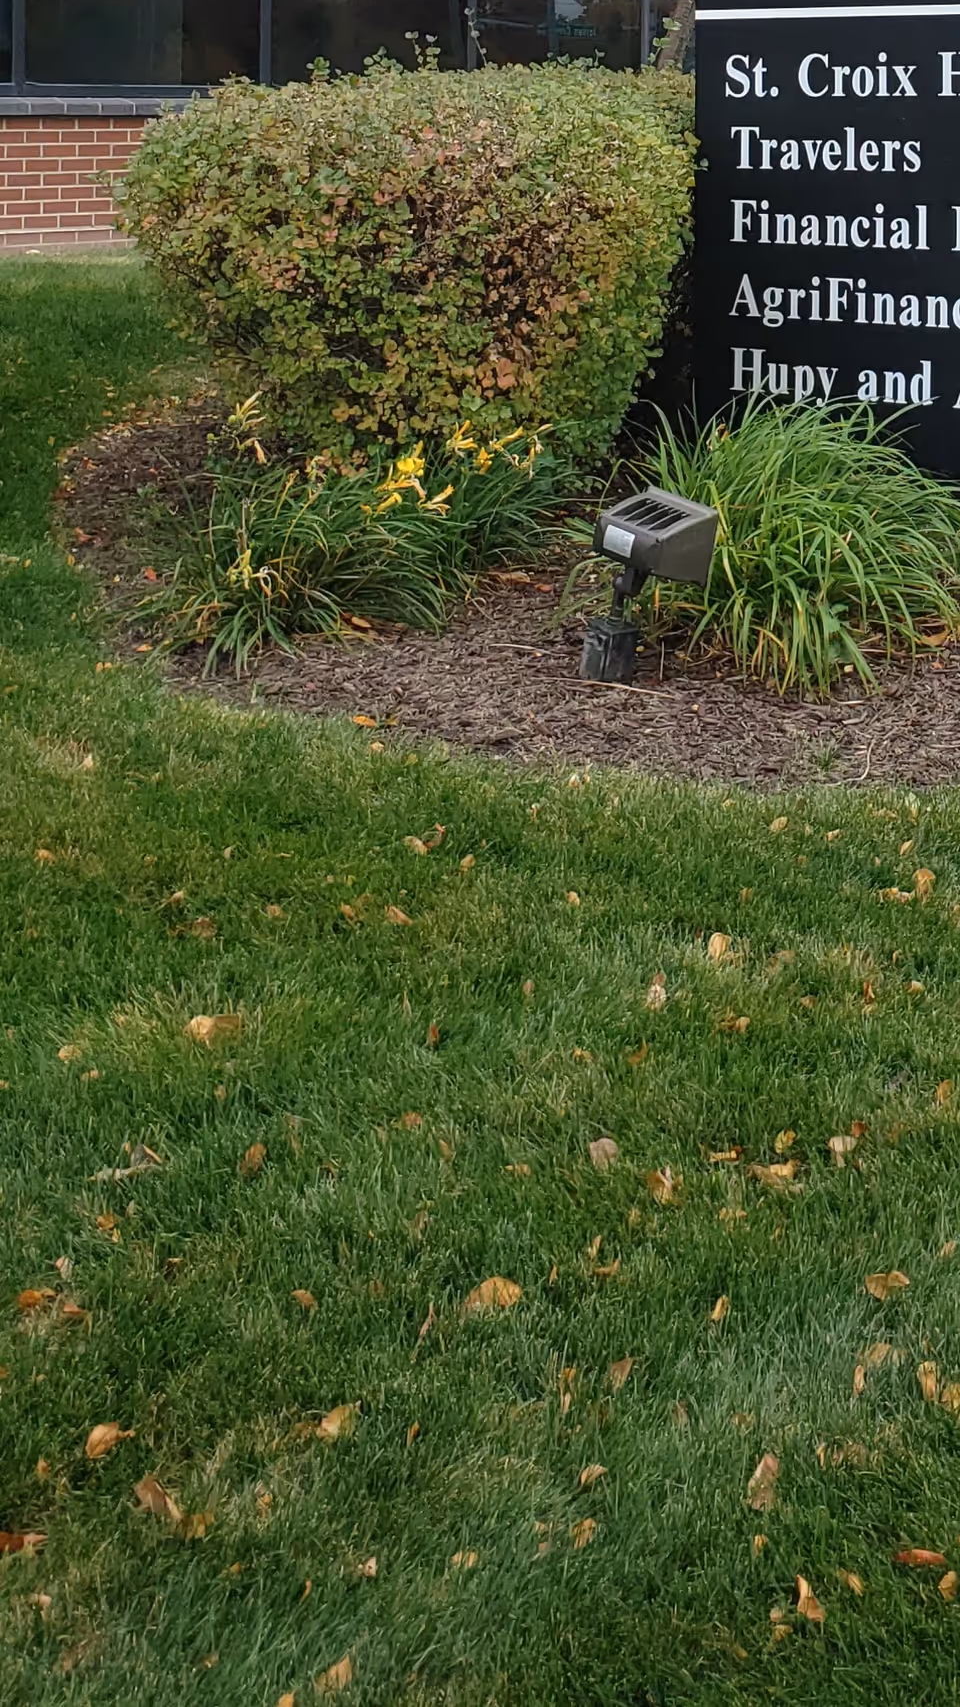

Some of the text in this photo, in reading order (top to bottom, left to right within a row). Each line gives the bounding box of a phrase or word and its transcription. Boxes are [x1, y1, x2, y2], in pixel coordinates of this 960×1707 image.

[725, 54, 780, 98] St.
[797, 51, 918, 98] Croix
[730, 126, 922, 173] Travelers
[729, 199, 931, 251] Financial
[729, 346, 839, 408] Hupy
[857, 359, 934, 406] and
